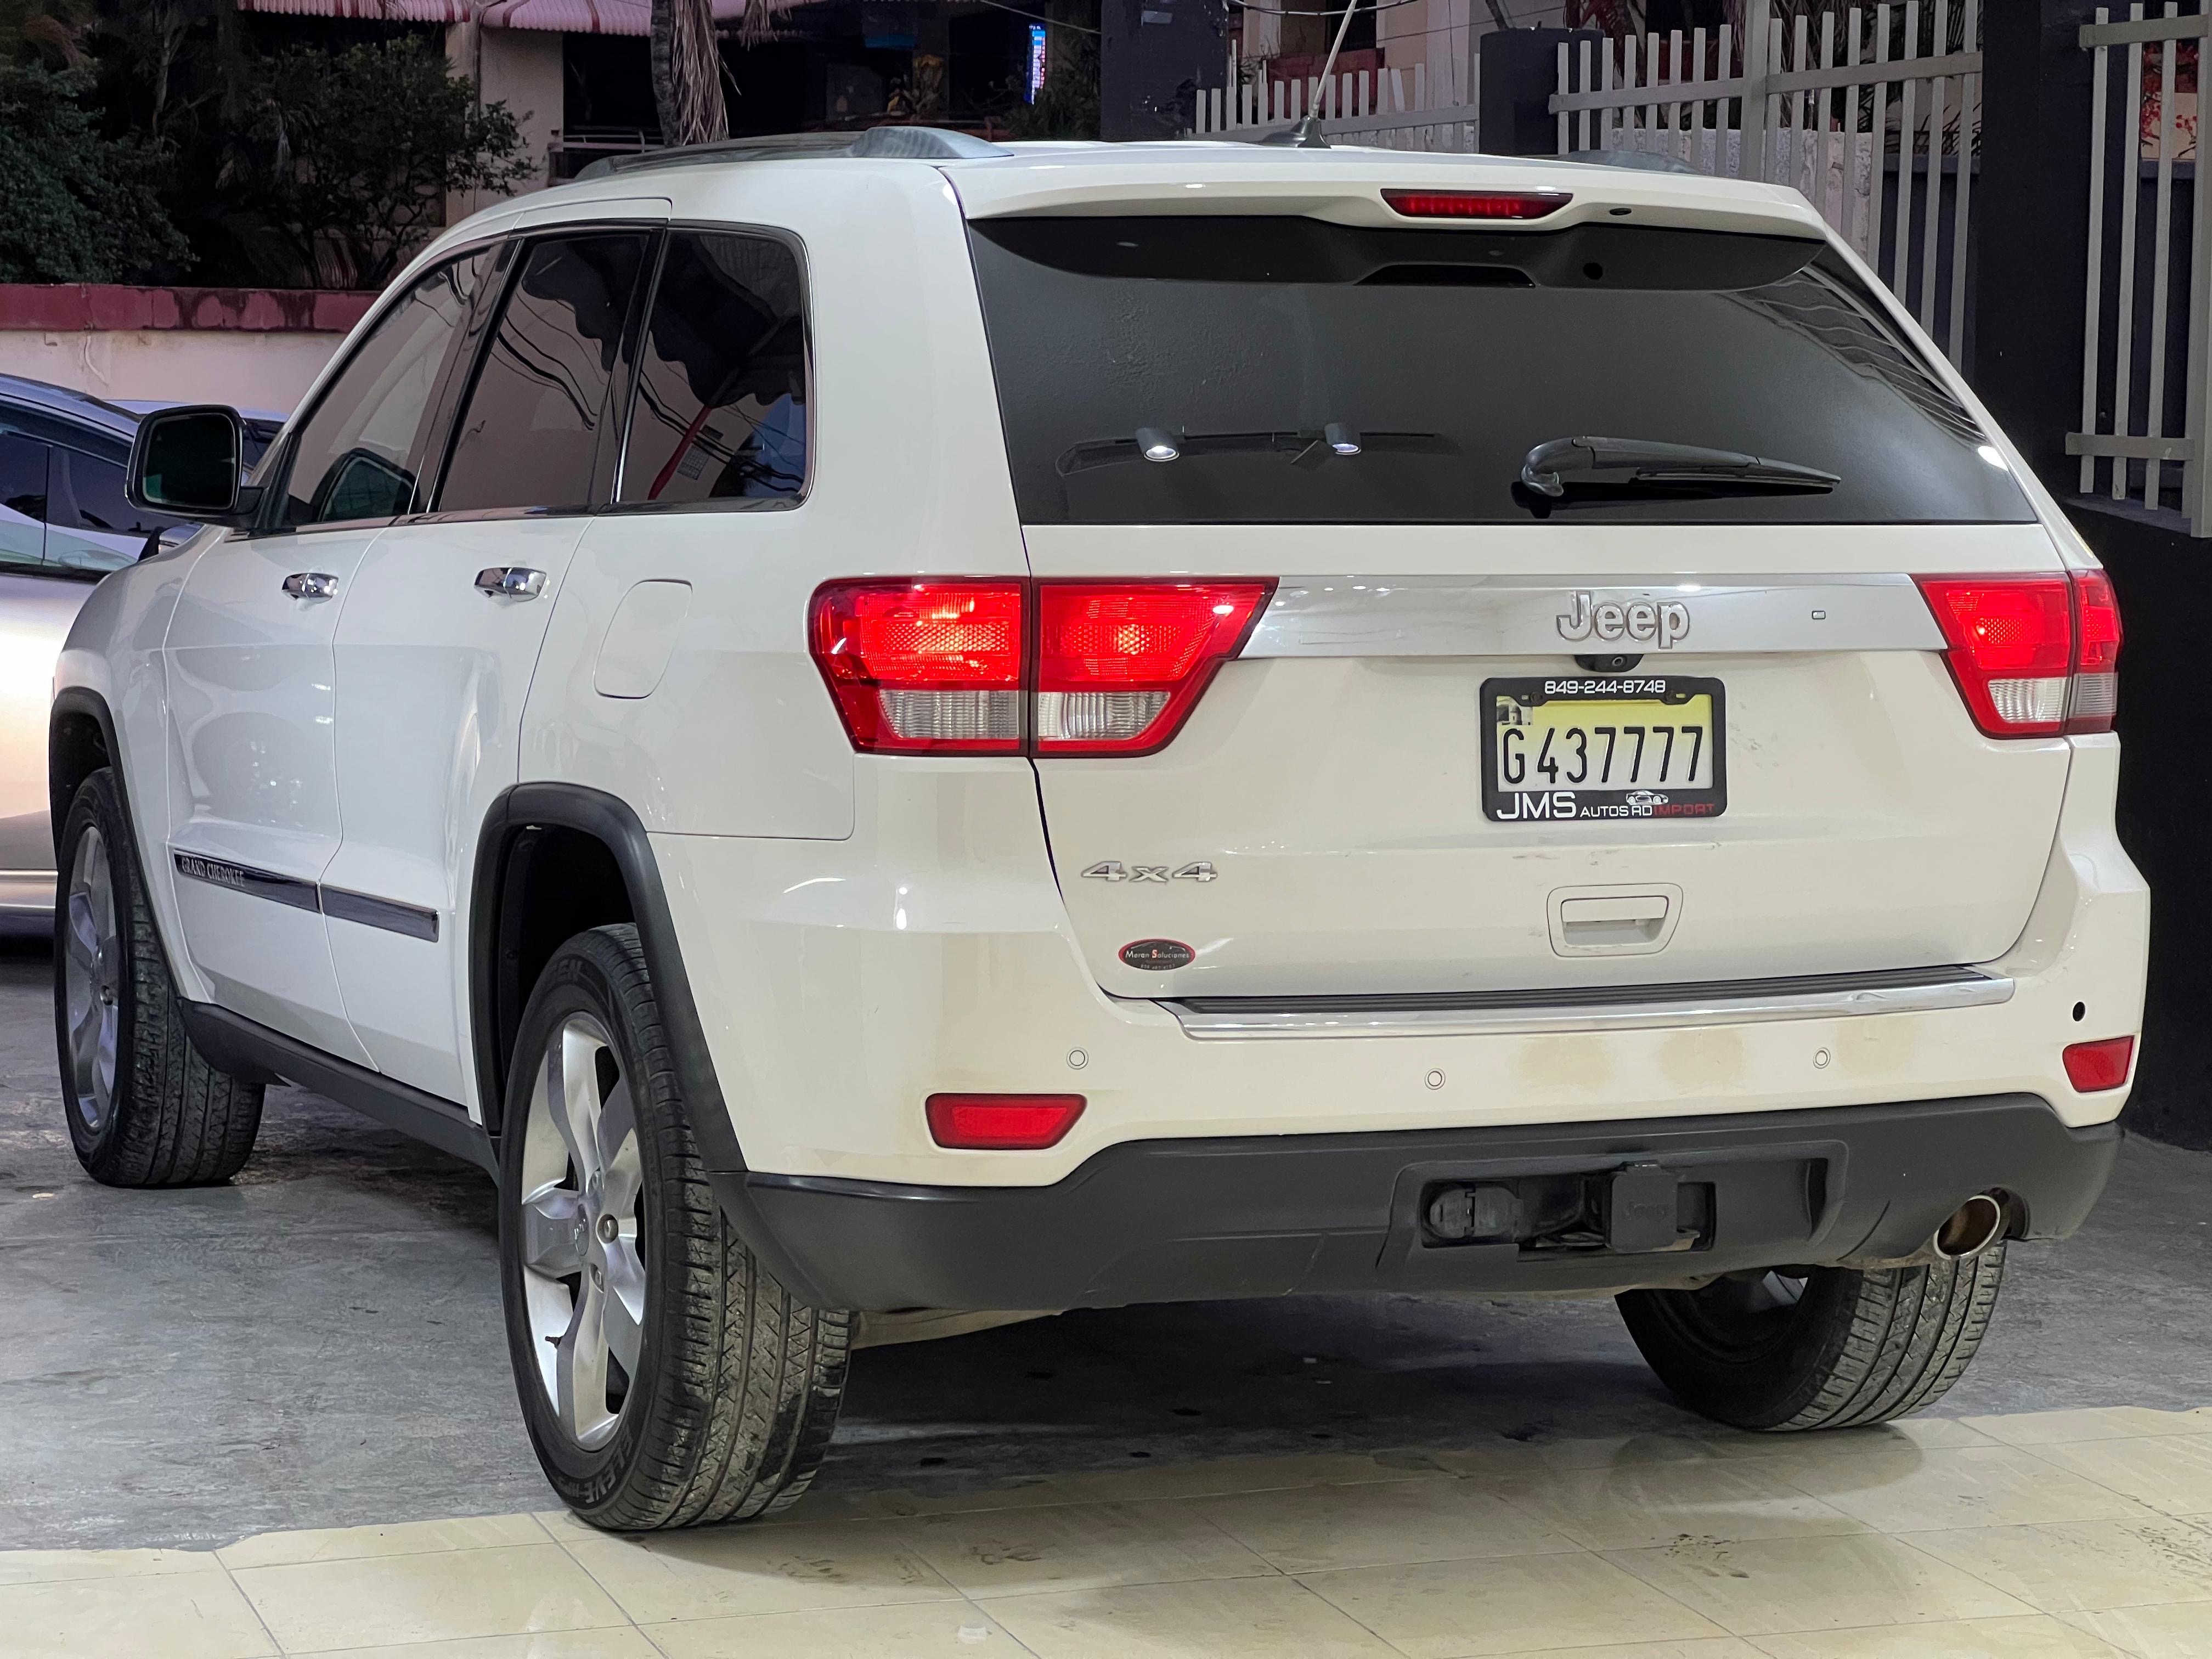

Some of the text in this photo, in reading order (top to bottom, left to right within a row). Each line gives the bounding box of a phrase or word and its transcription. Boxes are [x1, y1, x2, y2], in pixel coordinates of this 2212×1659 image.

[1556, 590, 1690, 650] Jeep
[1544, 680, 1666, 695] 849-244-8748
[1503, 726, 1703, 784] G437777
[1496, 792, 1577, 820] JMS
[1579, 806, 1629, 817] AUTOS
[1654, 803, 1716, 816] IMPORT
[181, 856, 246, 888] GRAND CHEROKEE
[1081, 860, 1218, 882] 4x4
[1152, 949, 1189, 959] Soluciones
